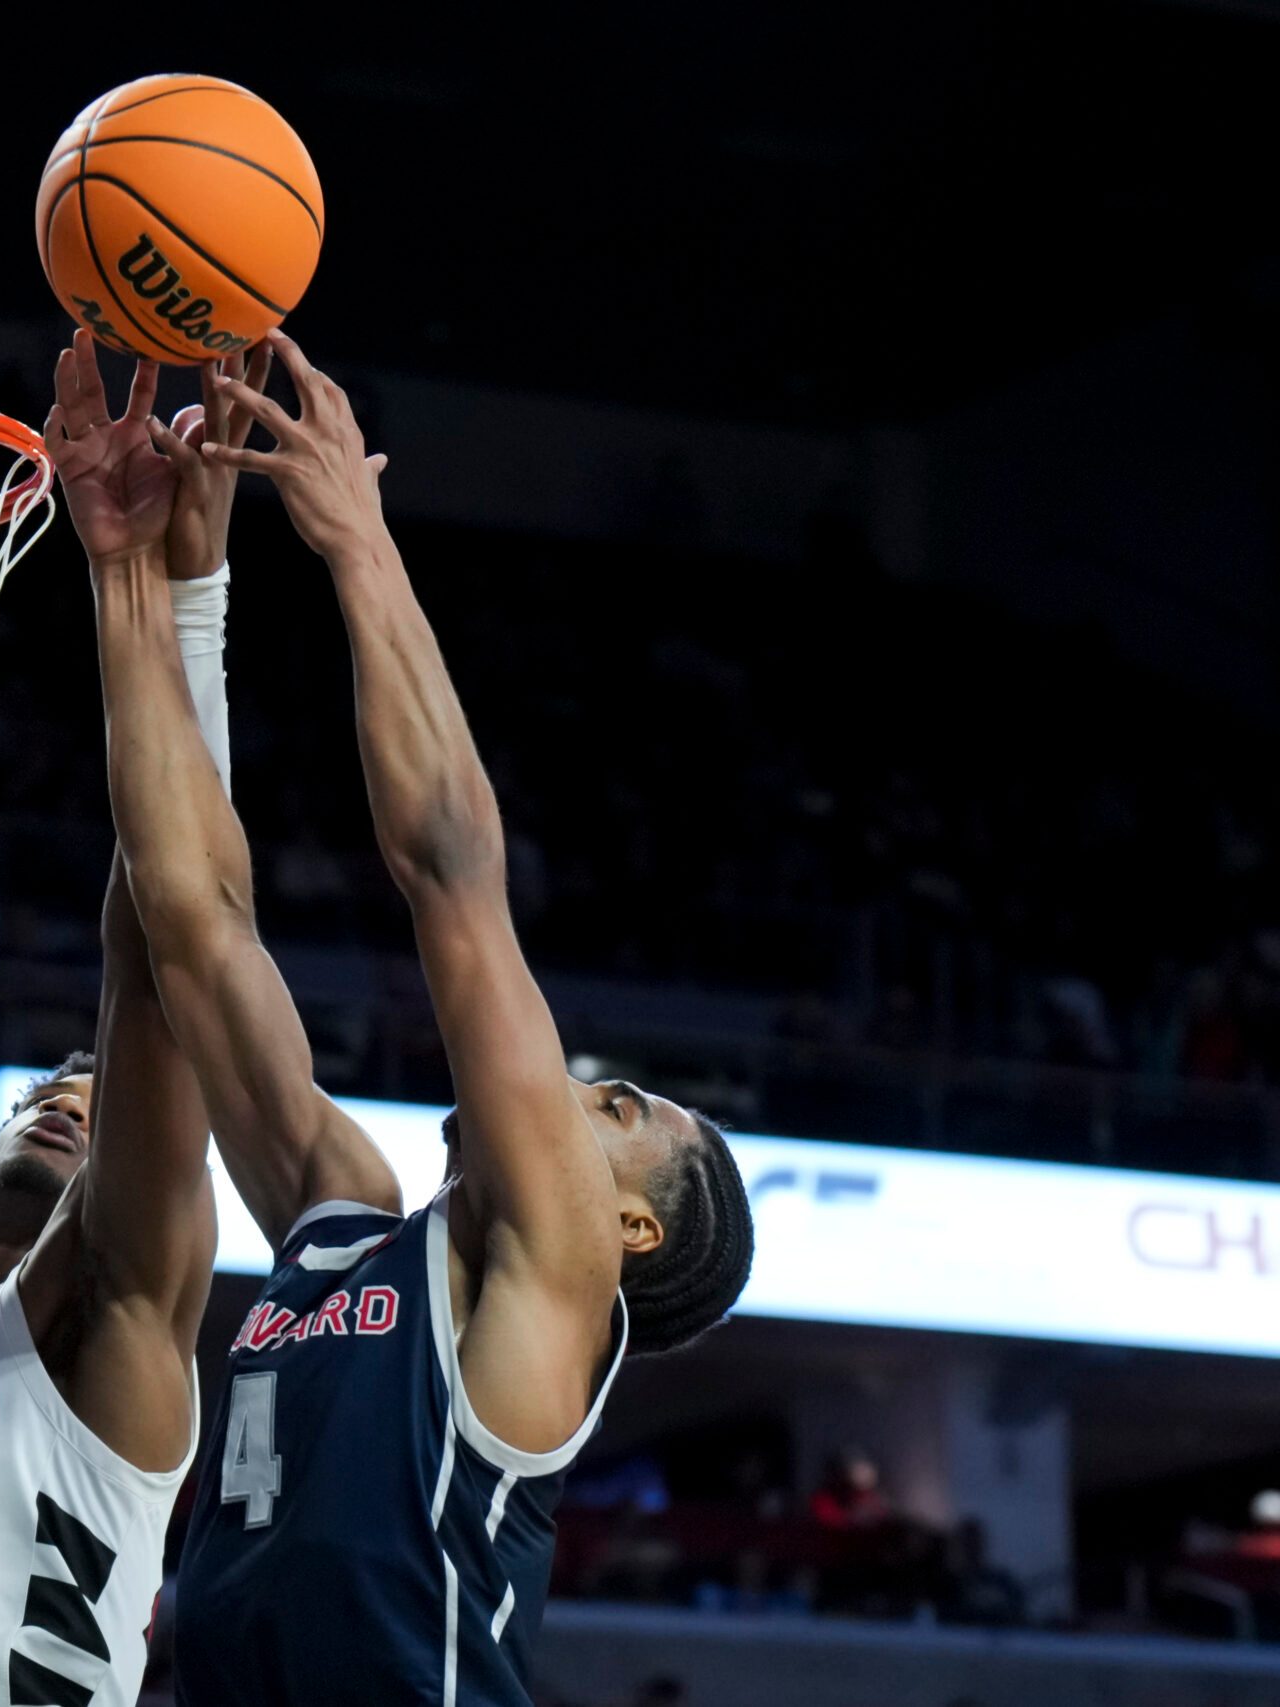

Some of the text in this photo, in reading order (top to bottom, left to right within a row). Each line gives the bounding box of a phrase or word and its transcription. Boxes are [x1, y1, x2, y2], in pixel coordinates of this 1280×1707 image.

[117, 231, 254, 355] Wilson
[229, 1284, 400, 1356] OWARD
[220, 1371, 282, 1531] 4
